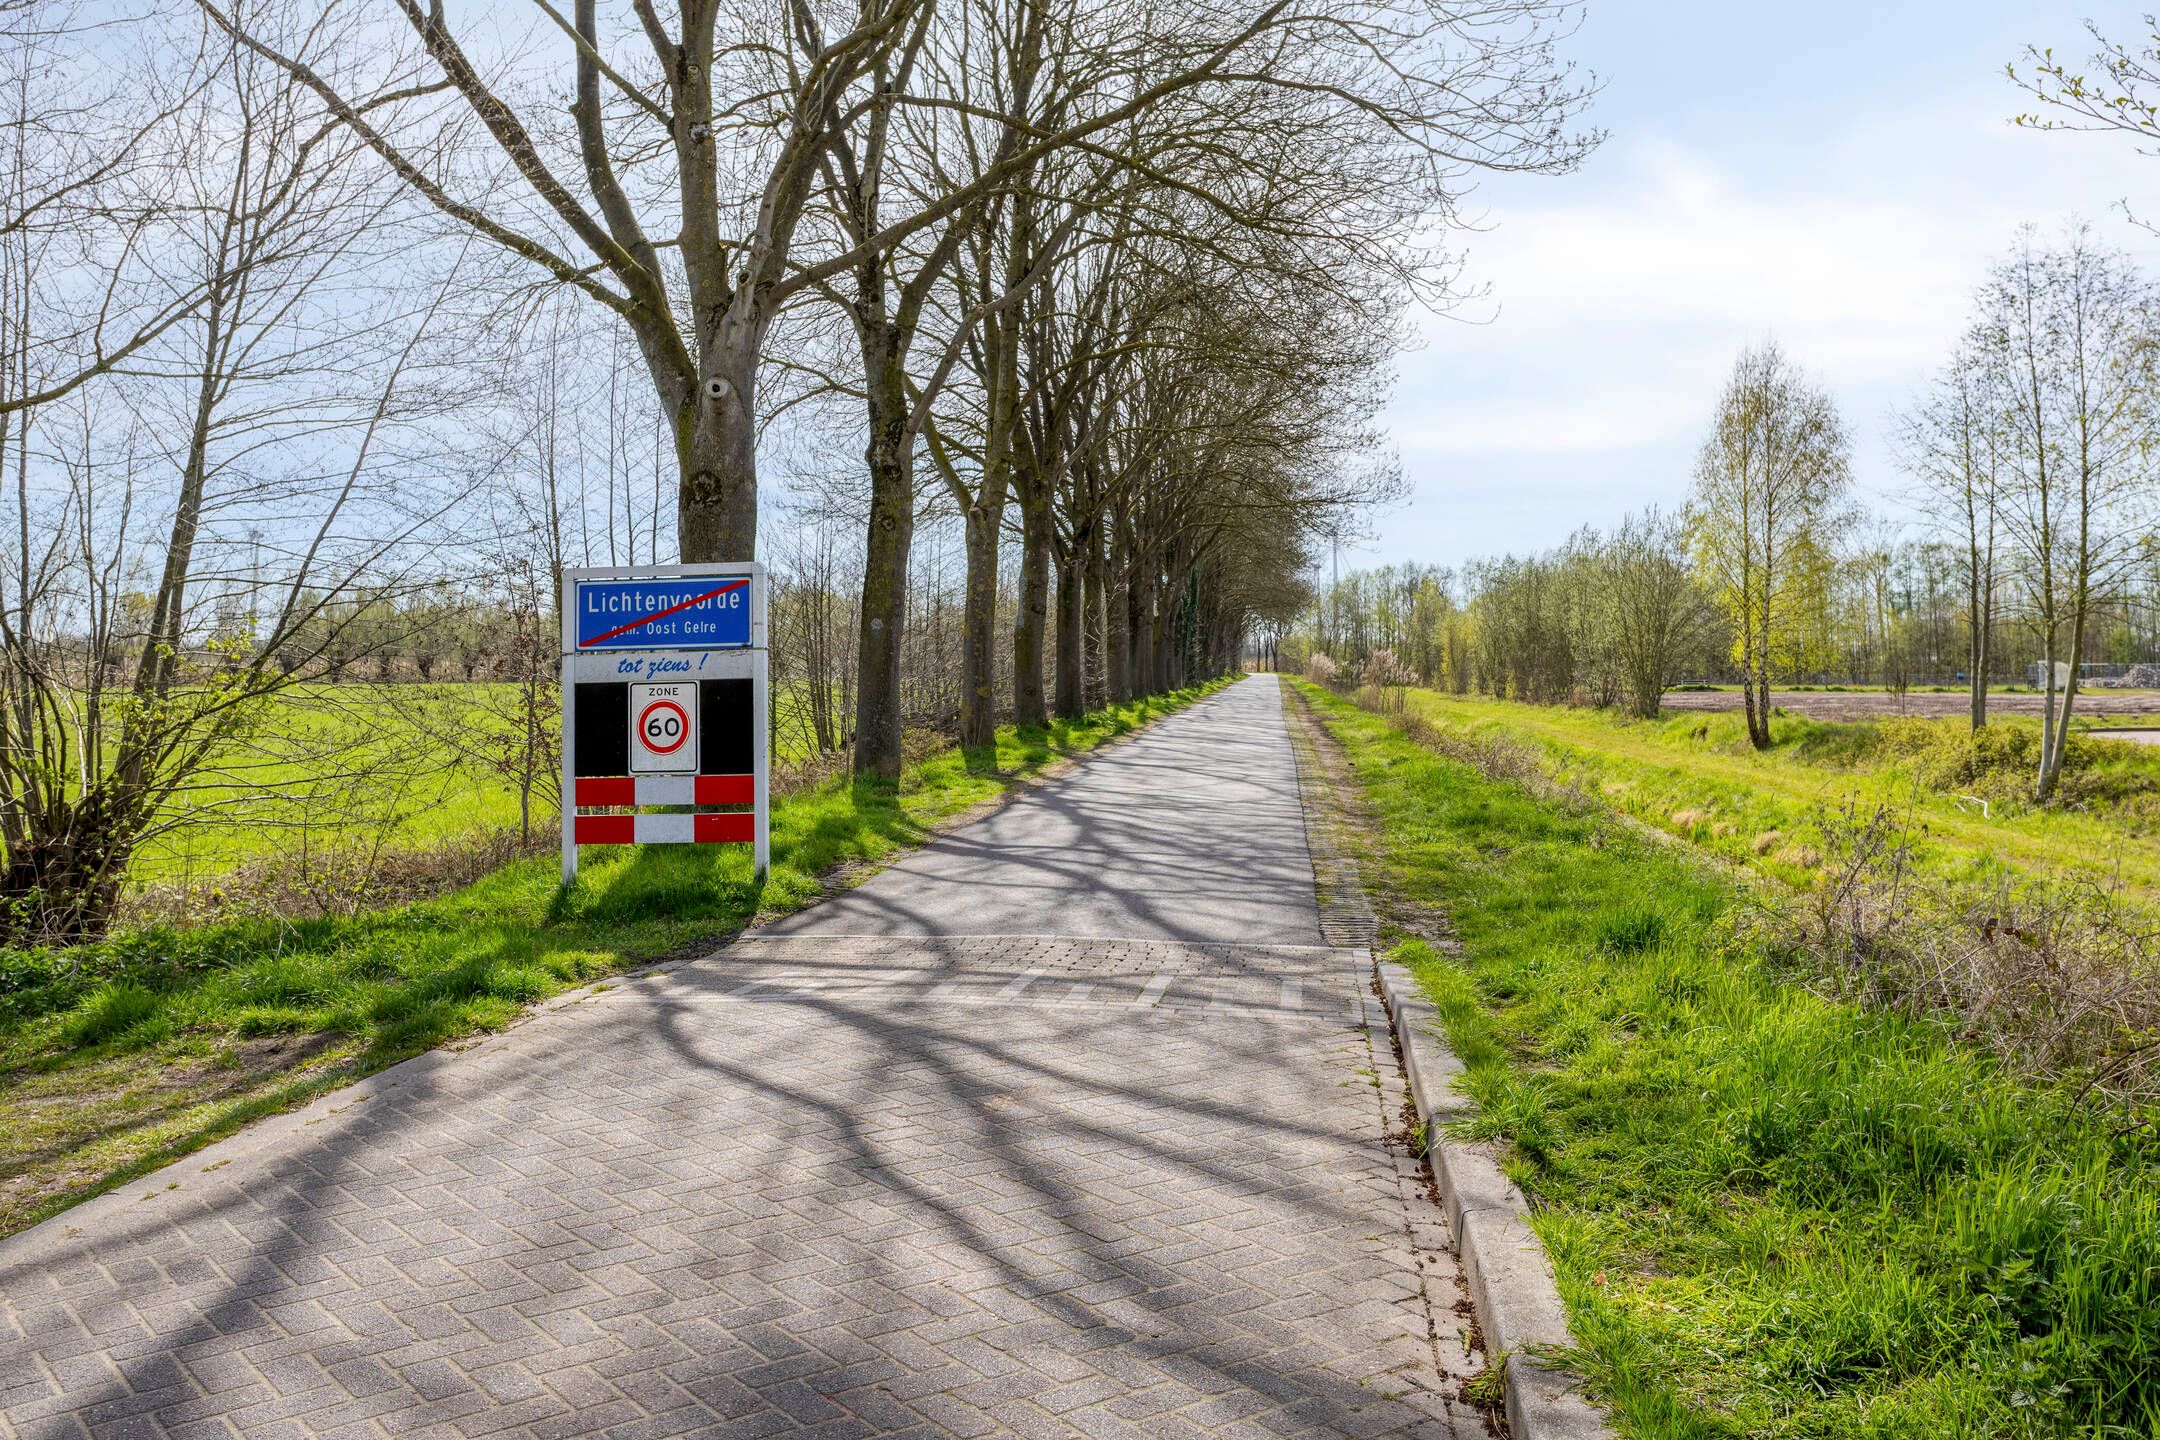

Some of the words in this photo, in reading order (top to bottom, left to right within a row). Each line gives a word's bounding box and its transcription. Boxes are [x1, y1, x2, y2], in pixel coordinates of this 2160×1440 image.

[647, 622, 677, 635] Oost
[684, 621, 716, 634] Gelre
[617, 658, 643, 673] tot
[646, 657, 692, 680] ziens
[648, 687, 680, 696] ZONE
[647, 717, 680, 737] 60
